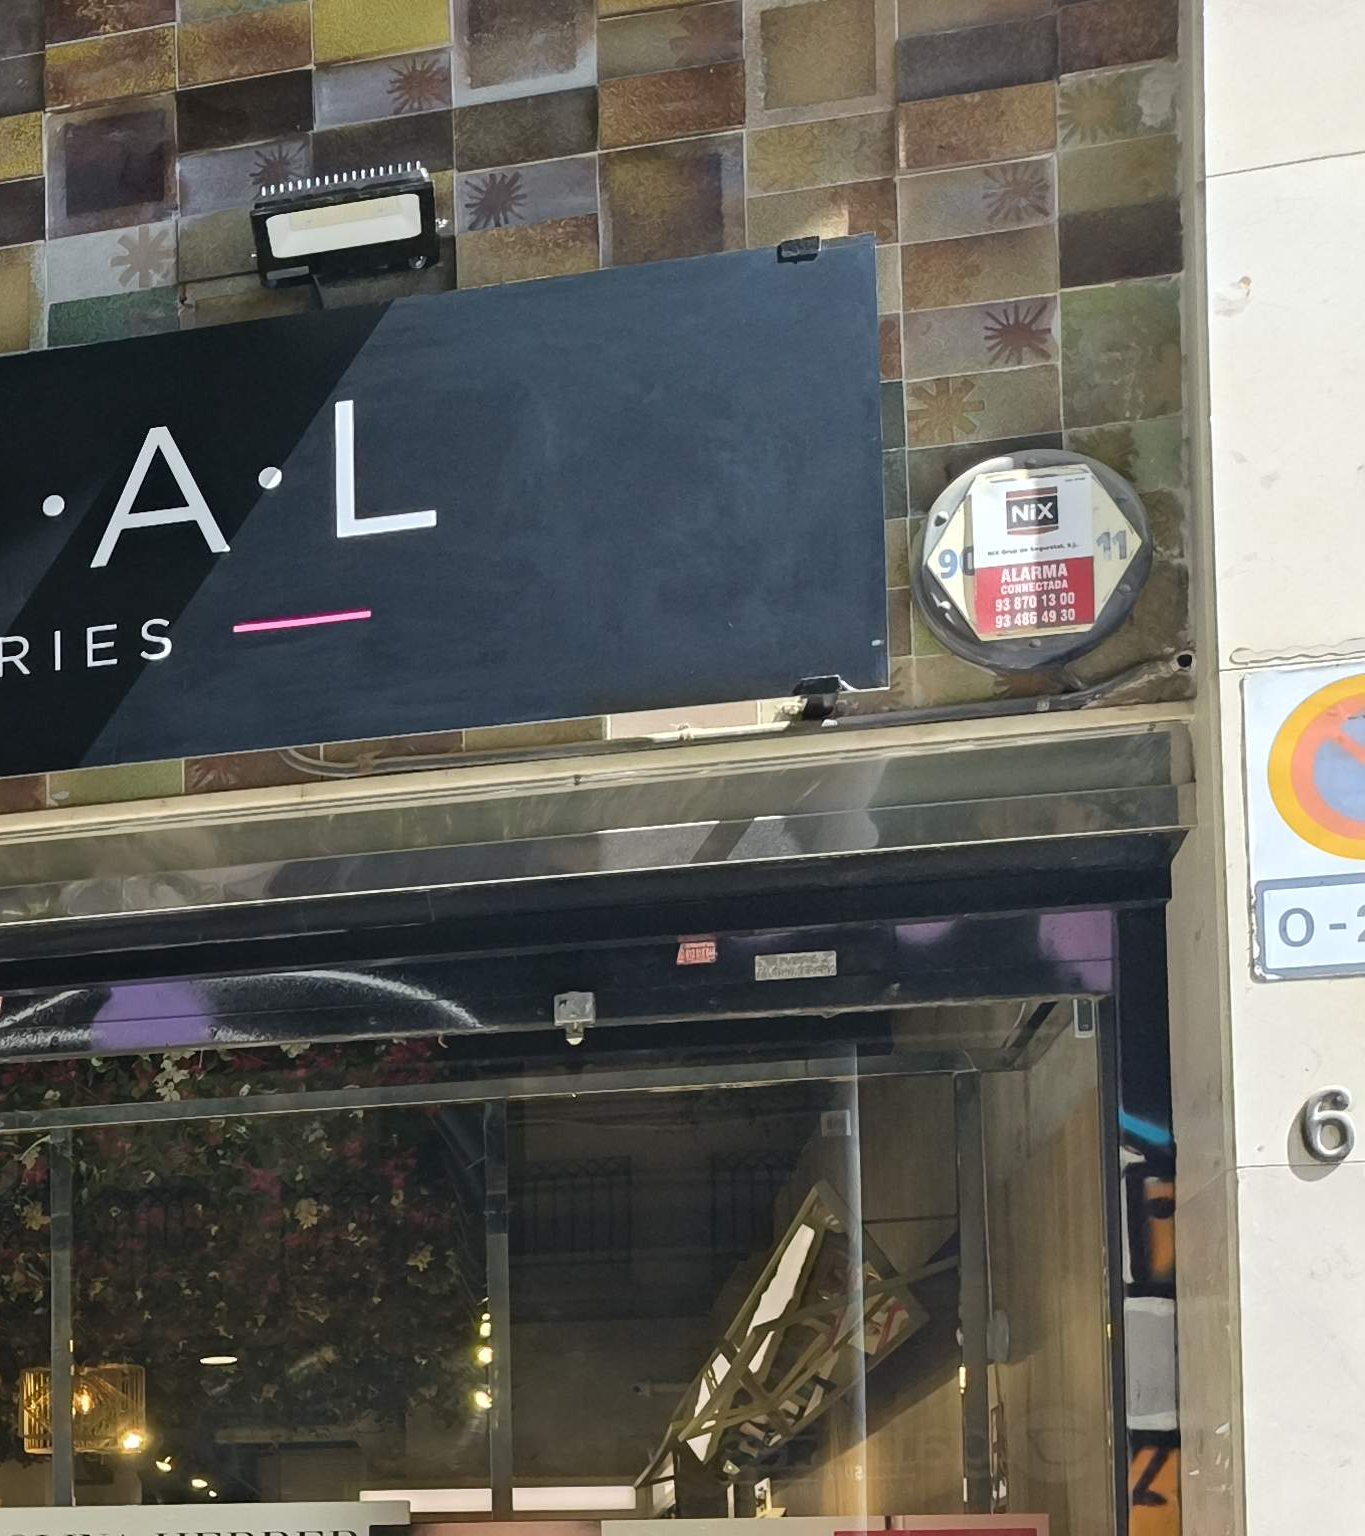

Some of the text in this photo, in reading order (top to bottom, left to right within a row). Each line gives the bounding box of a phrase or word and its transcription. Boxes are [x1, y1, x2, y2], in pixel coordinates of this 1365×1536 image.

[1001, 563, 1067, 583] ALARMA
[1000, 579, 1068, 595] CONNECTADA
[995, 592, 1075, 612] 93 870 13 00
[995, 614, 1011, 629] 93
[1042, 610, 1056, 623] 49
[1061, 609, 1075, 621] 30
[1300, 1086, 1356, 1162] 6
